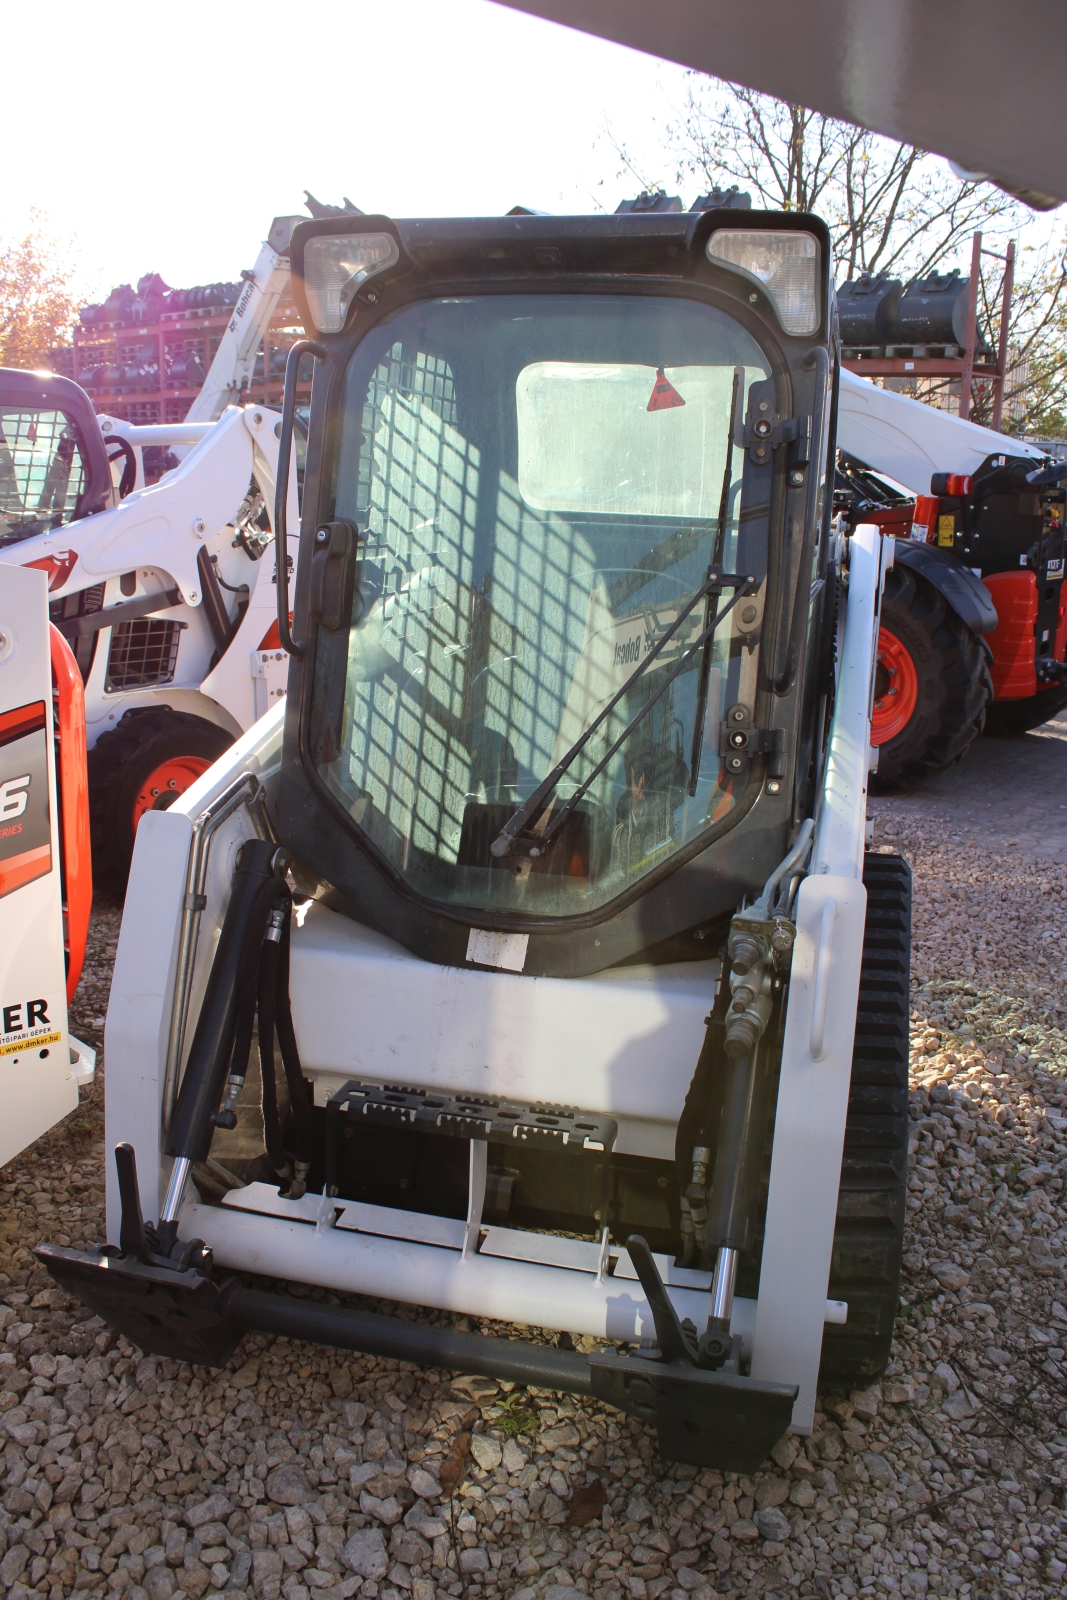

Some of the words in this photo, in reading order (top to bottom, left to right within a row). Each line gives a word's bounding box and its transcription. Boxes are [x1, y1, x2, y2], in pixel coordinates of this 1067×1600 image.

[236, 282, 255, 318] Bobca
[0, 999, 51, 1034] ER
[5, 1035, 59, 1053] www.dmker.hu
